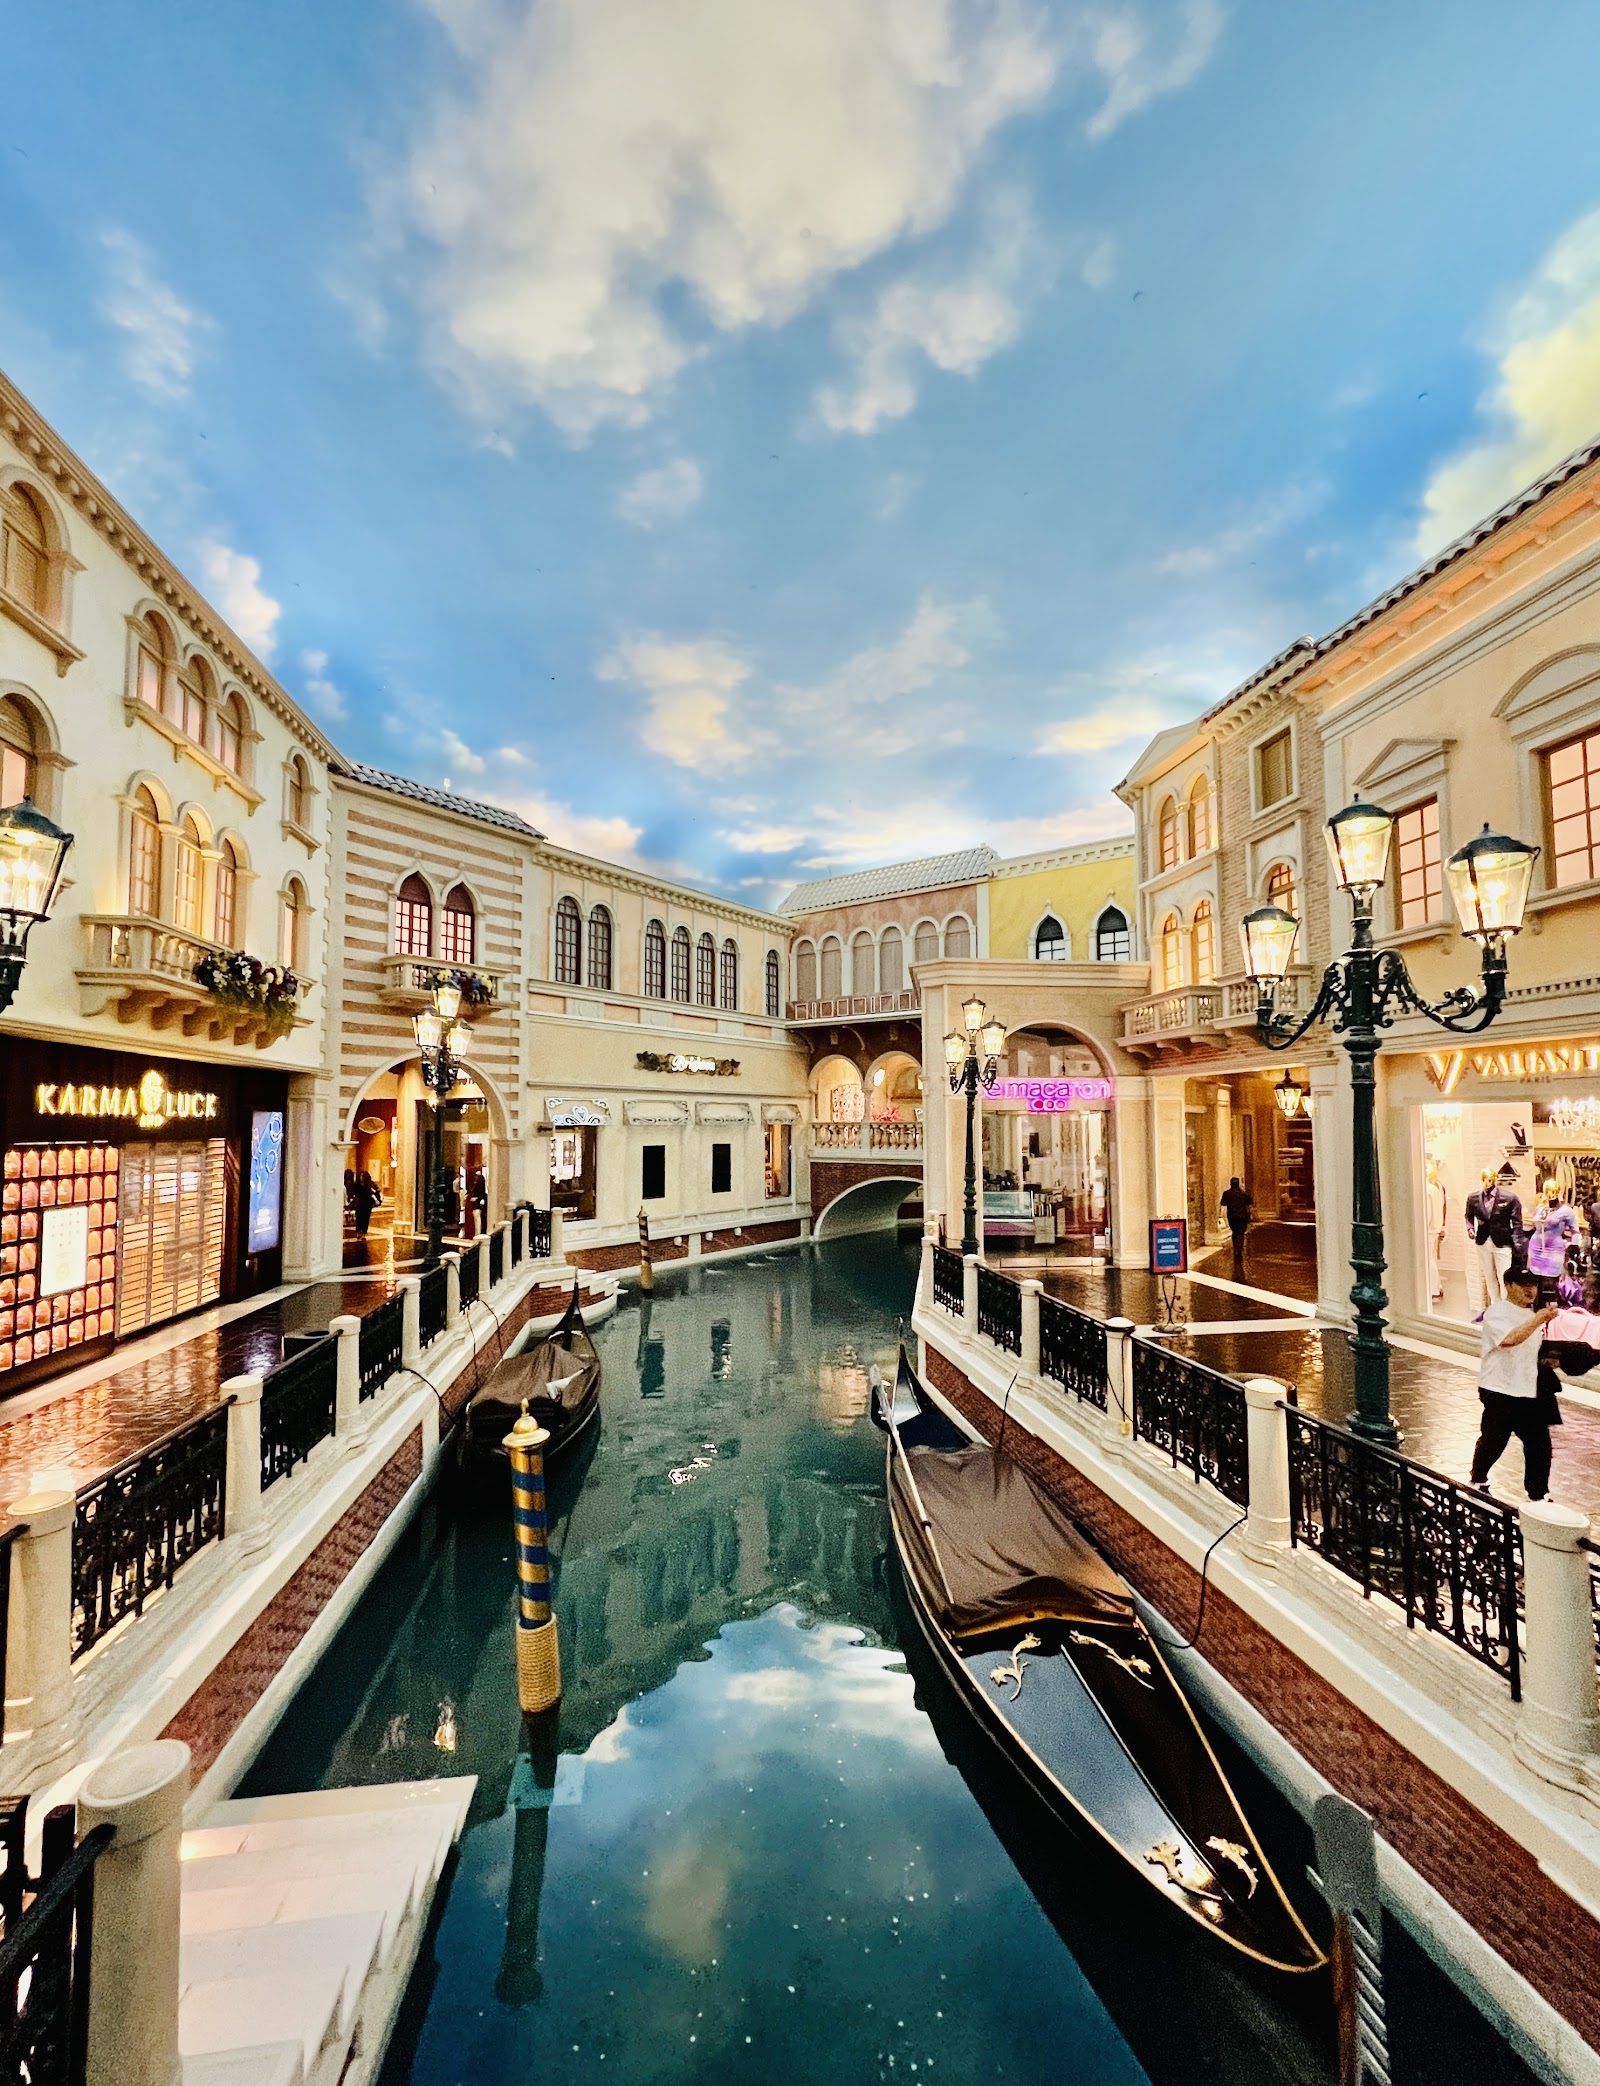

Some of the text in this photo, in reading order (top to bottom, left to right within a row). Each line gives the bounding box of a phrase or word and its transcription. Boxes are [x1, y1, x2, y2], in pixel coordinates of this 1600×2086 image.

[36, 1083, 139, 1117] KARMA
[165, 1090, 218, 1118] LUCK
[1003, 1080, 1112, 1099] macaron
